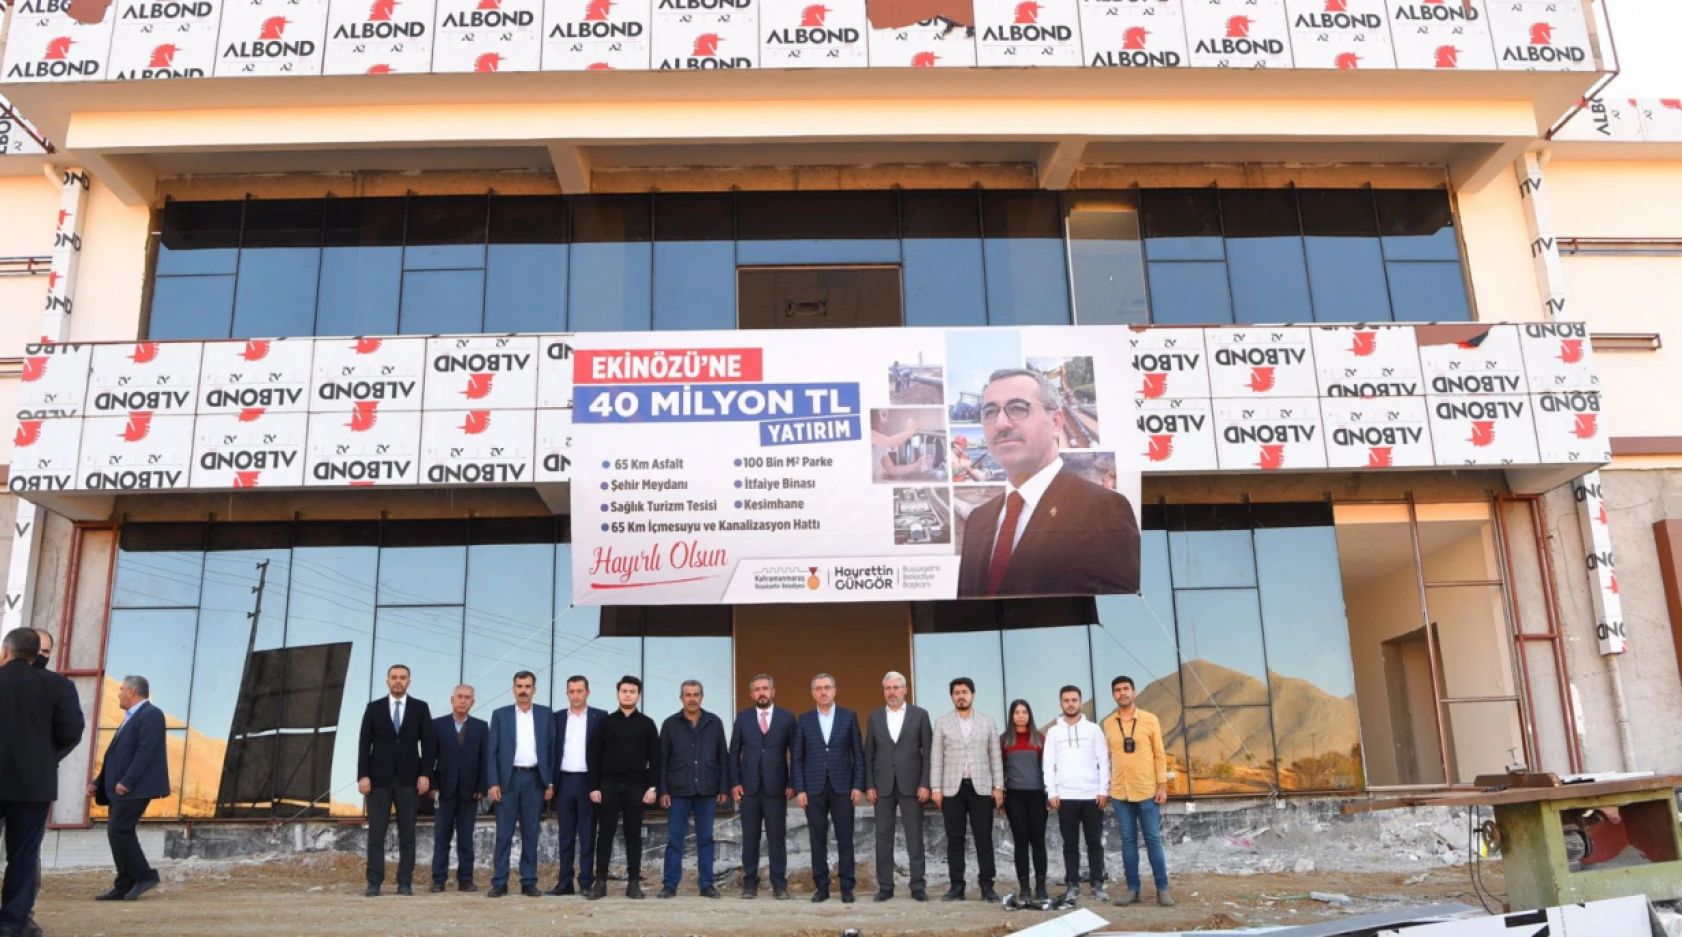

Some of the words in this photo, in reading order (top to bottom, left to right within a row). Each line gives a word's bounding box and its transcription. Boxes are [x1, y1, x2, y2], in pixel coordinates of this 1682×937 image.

[123, 2, 212, 19] ALBOND
[443, 8, 533, 27] ALBOND
[1396, 5, 1478, 20] ALBOND
[1295, 13, 1381, 29] ALBOND
[333, 22, 425, 38] ALBOND
[549, 22, 642, 37] ALBOND
[767, 28, 859, 44] ALBOND
[983, 25, 1071, 41] ALBOND
[224, 38, 315, 57] ALBOND
[1195, 38, 1283, 54] ALBOND
[1503, 46, 1585, 62] ALBOND
[1092, 51, 1180, 66] ALBOND
[8, 58, 99, 77] ALBOND
[434, 354, 530, 372] ALBOND
[1215, 348, 1305, 368] ALBOND
[319, 381, 415, 399] ALBOND
[1432, 376, 1520, 392] ALBOND
[95, 392, 189, 412] ALBOND
[206, 388, 302, 409] ALBOND
[589, 391, 639, 417] 40
[651, 385, 793, 416] MİLYON
[805, 389, 850, 413] TL
[1436, 402, 1524, 419] ALBOND
[768, 421, 850, 442] YATIRIM
[1224, 425, 1315, 443] ALBOND
[1333, 427, 1422, 445] ALBOND
[201, 451, 297, 472] ALBOND
[615, 459, 628, 470] 65
[631, 459, 649, 469] Km
[652, 459, 683, 469] Asfalt
[743, 457, 763, 467] 100
[766, 457, 783, 467] Bin
[802, 456, 833, 466] Parke
[313, 461, 410, 480] ALBOND
[428, 463, 528, 484] ALBOND
[85, 470, 182, 489] ALBOND
[611, 479, 640, 492] Şehir
[642, 479, 688, 491] Meydanı
[745, 477, 780, 490] İtfaiye
[783, 478, 815, 488] Binası
[611, 501, 644, 514] Sağlık
[647, 500, 684, 511] Turizm
[687, 500, 717, 511] Tesisi
[744, 499, 804, 510] Kesimhane
[611, 522, 625, 533] 65
[628, 521, 645, 532] Km
[649, 519, 701, 533] İçmesuyu
[704, 522, 716, 531] ve
[719, 519, 791, 531] Kanalizasyon
[794, 519, 820, 530] Hattı
[589, 543, 661, 583] Hayırlı
[669, 540, 727, 569] Olsun
[834, 565, 893, 578] Hayrettin
[835, 578, 893, 590] GÜNGÖR
